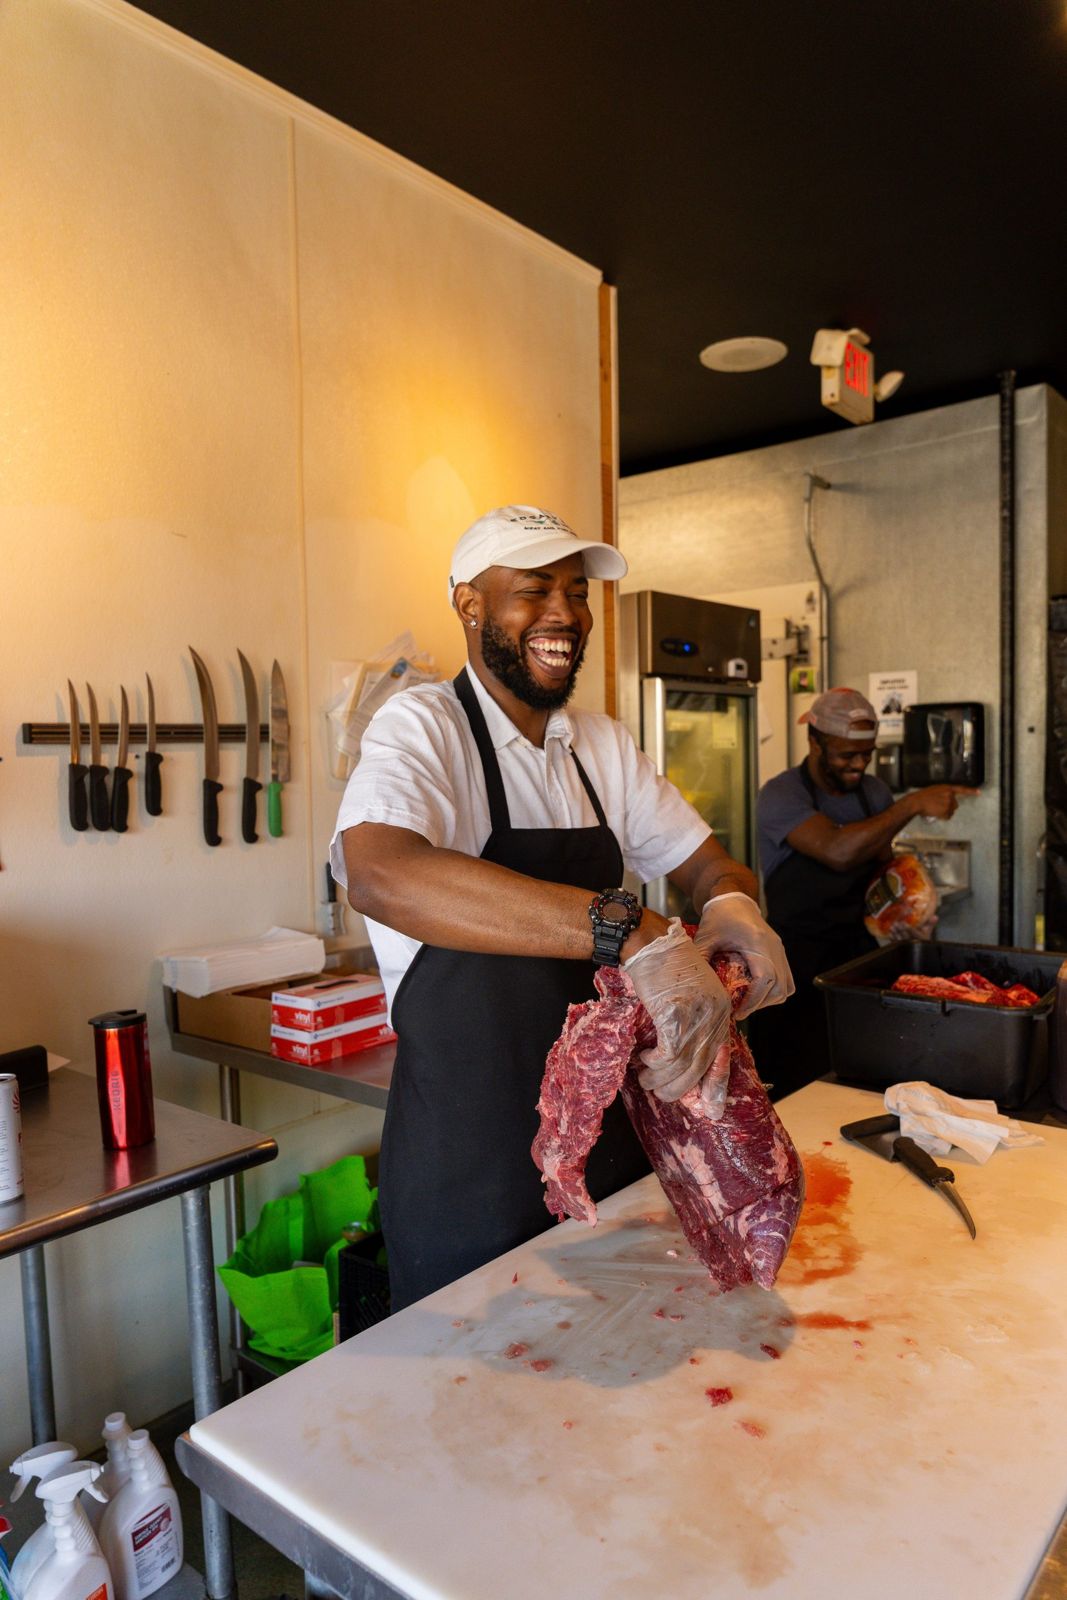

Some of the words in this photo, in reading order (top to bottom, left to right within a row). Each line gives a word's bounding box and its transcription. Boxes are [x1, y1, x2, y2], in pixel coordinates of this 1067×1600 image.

[845, 342, 869, 398] EXIT
[294, 1011, 310, 1024] vinyl
[292, 1044, 308, 1057] vinyl
